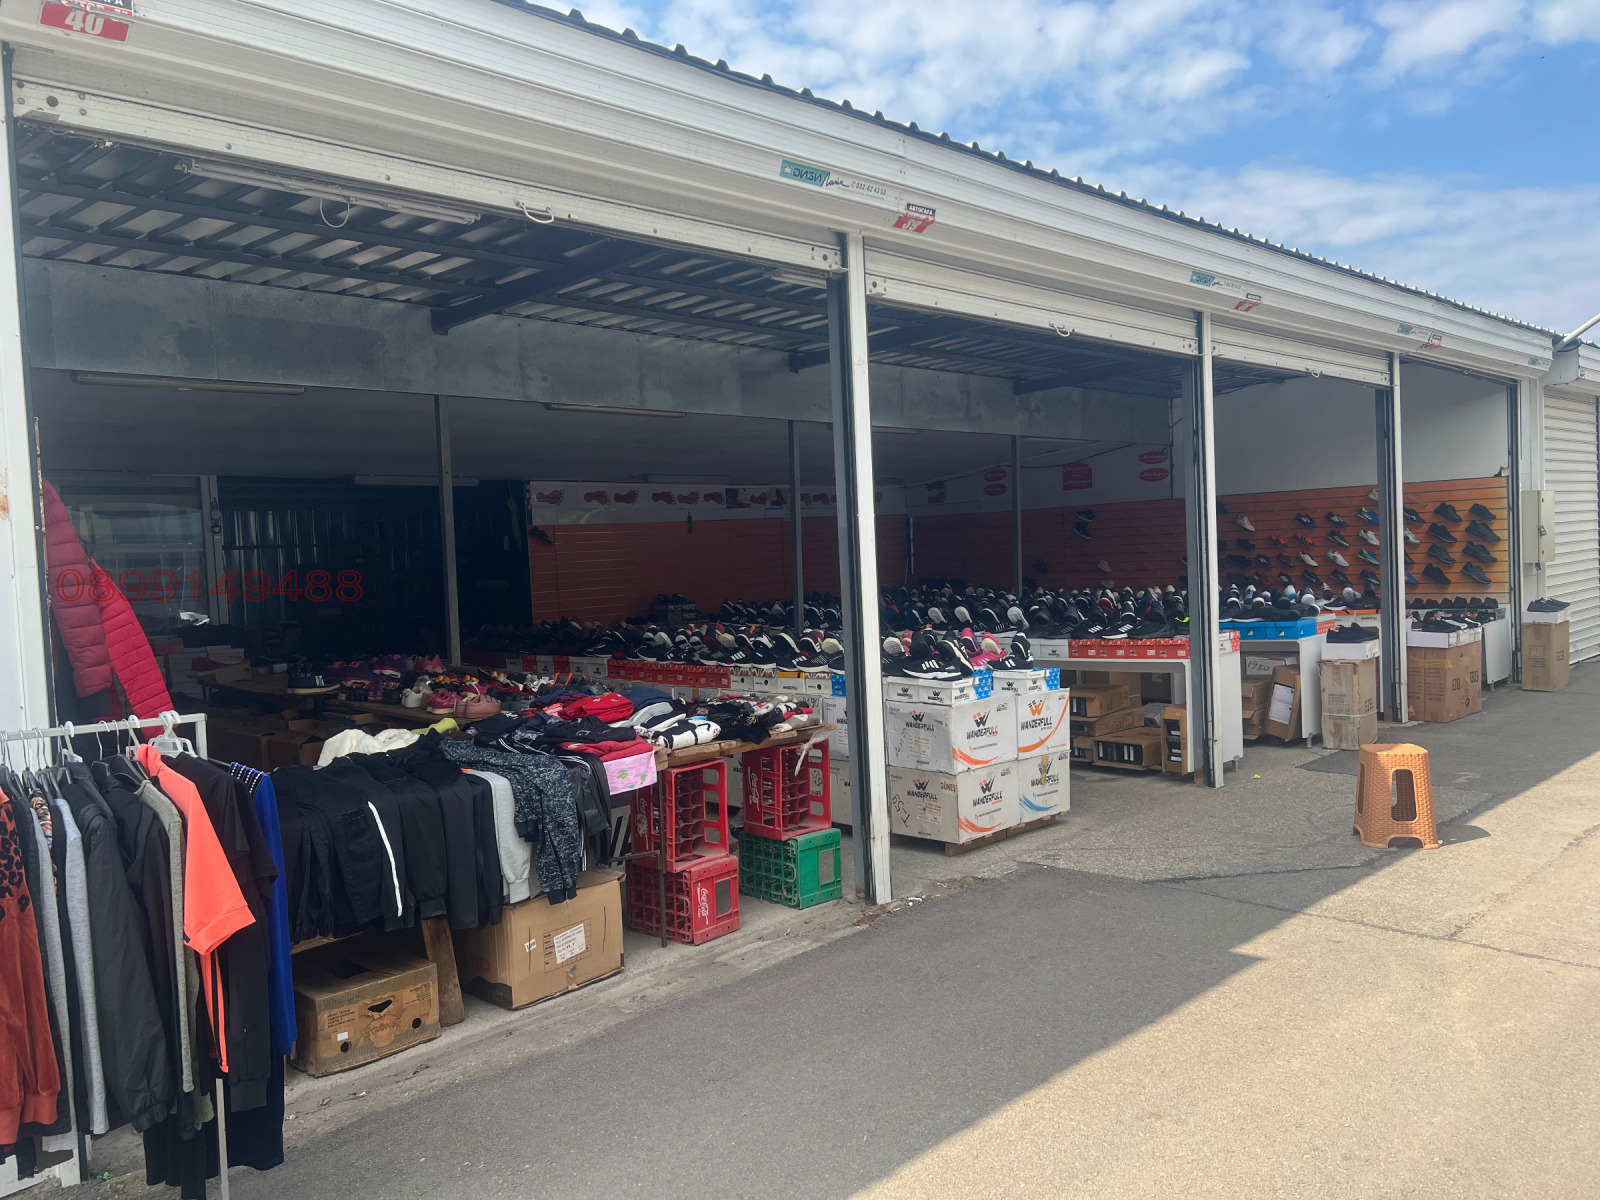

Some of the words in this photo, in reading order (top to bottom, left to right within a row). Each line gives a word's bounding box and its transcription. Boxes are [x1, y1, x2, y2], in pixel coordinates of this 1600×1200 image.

[65, 10, 105, 35] 40
[901, 219, 923, 231] 39
[1247, 660, 1271, 672] 1980
[905, 721, 935, 731] WANDERFULL
[1020, 716, 1053, 731] WANDERFULL
[966, 725, 998, 740] WANDERFULL
[906, 789, 938, 801] WANDERFULL
[972, 790, 1003, 807] WANDERFULL
